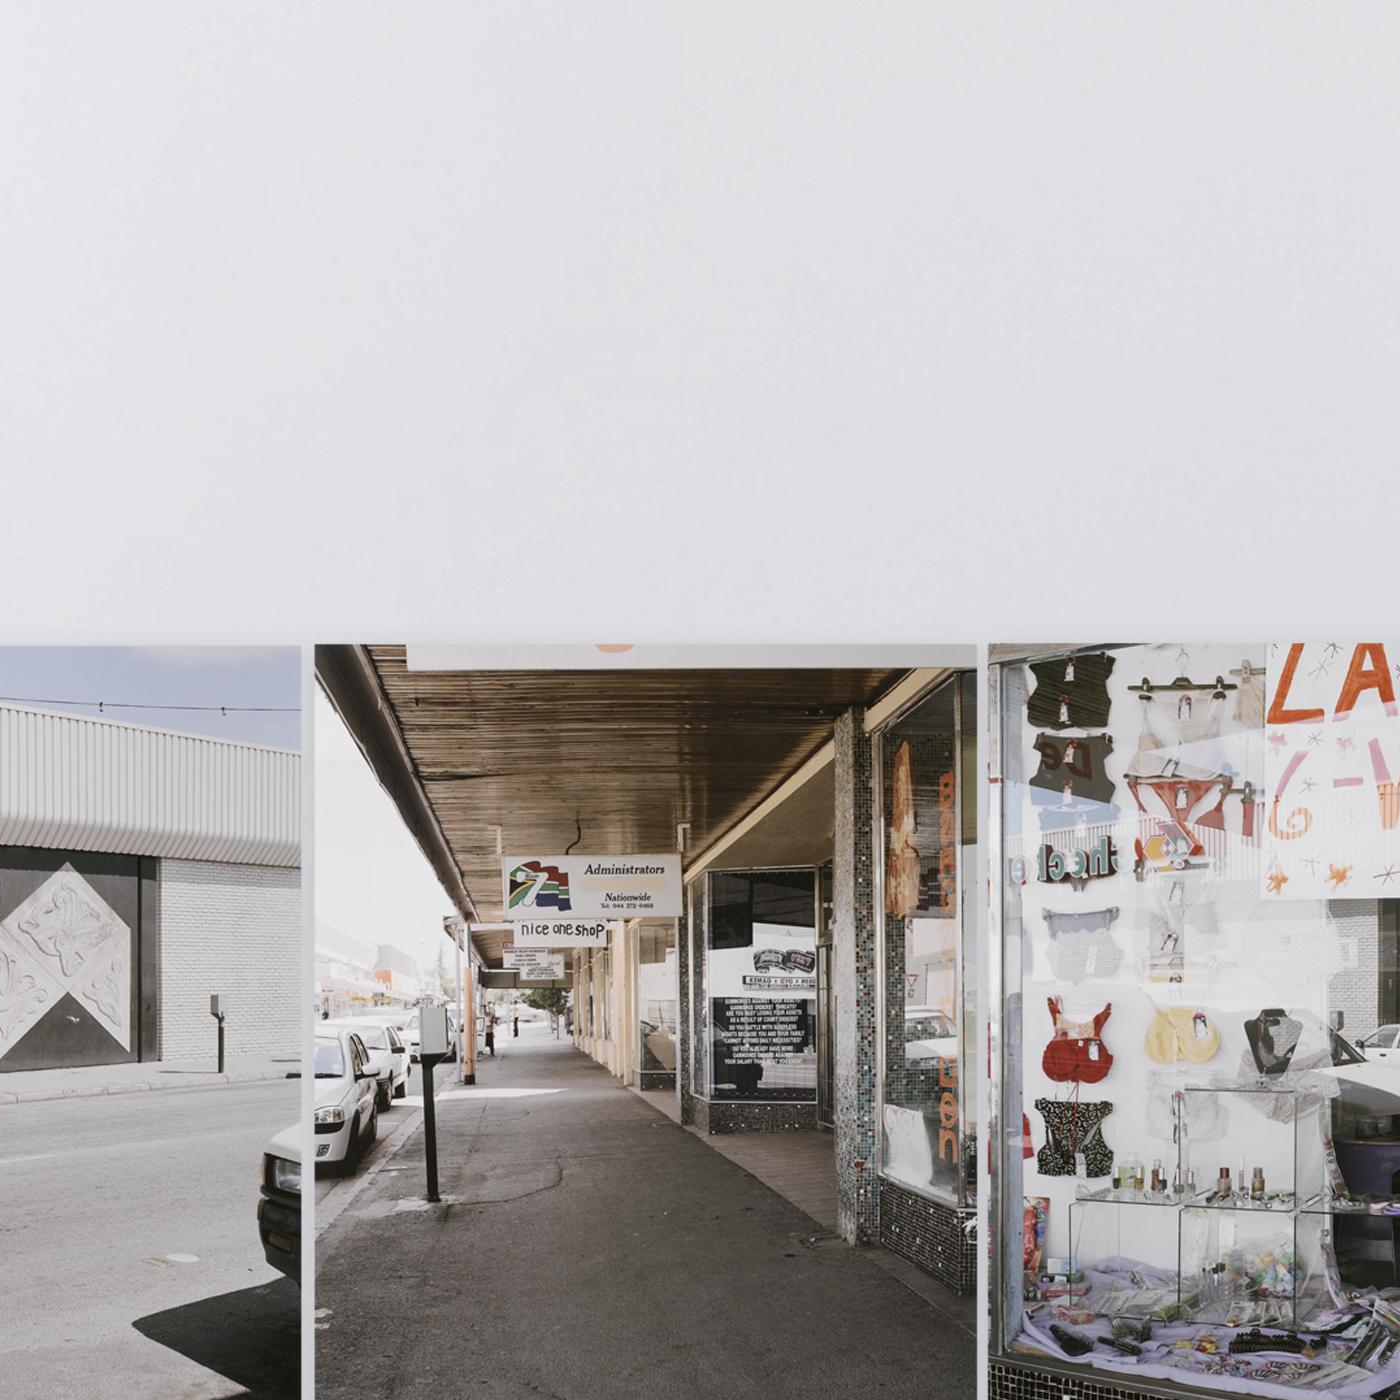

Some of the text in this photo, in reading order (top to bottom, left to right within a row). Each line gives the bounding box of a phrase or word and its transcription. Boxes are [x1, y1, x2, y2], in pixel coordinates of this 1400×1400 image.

[584, 864, 665, 876] Administrators
[604, 892, 651, 902] Nationwide
[521, 923, 549, 936] nice
[553, 923, 573, 935] one
